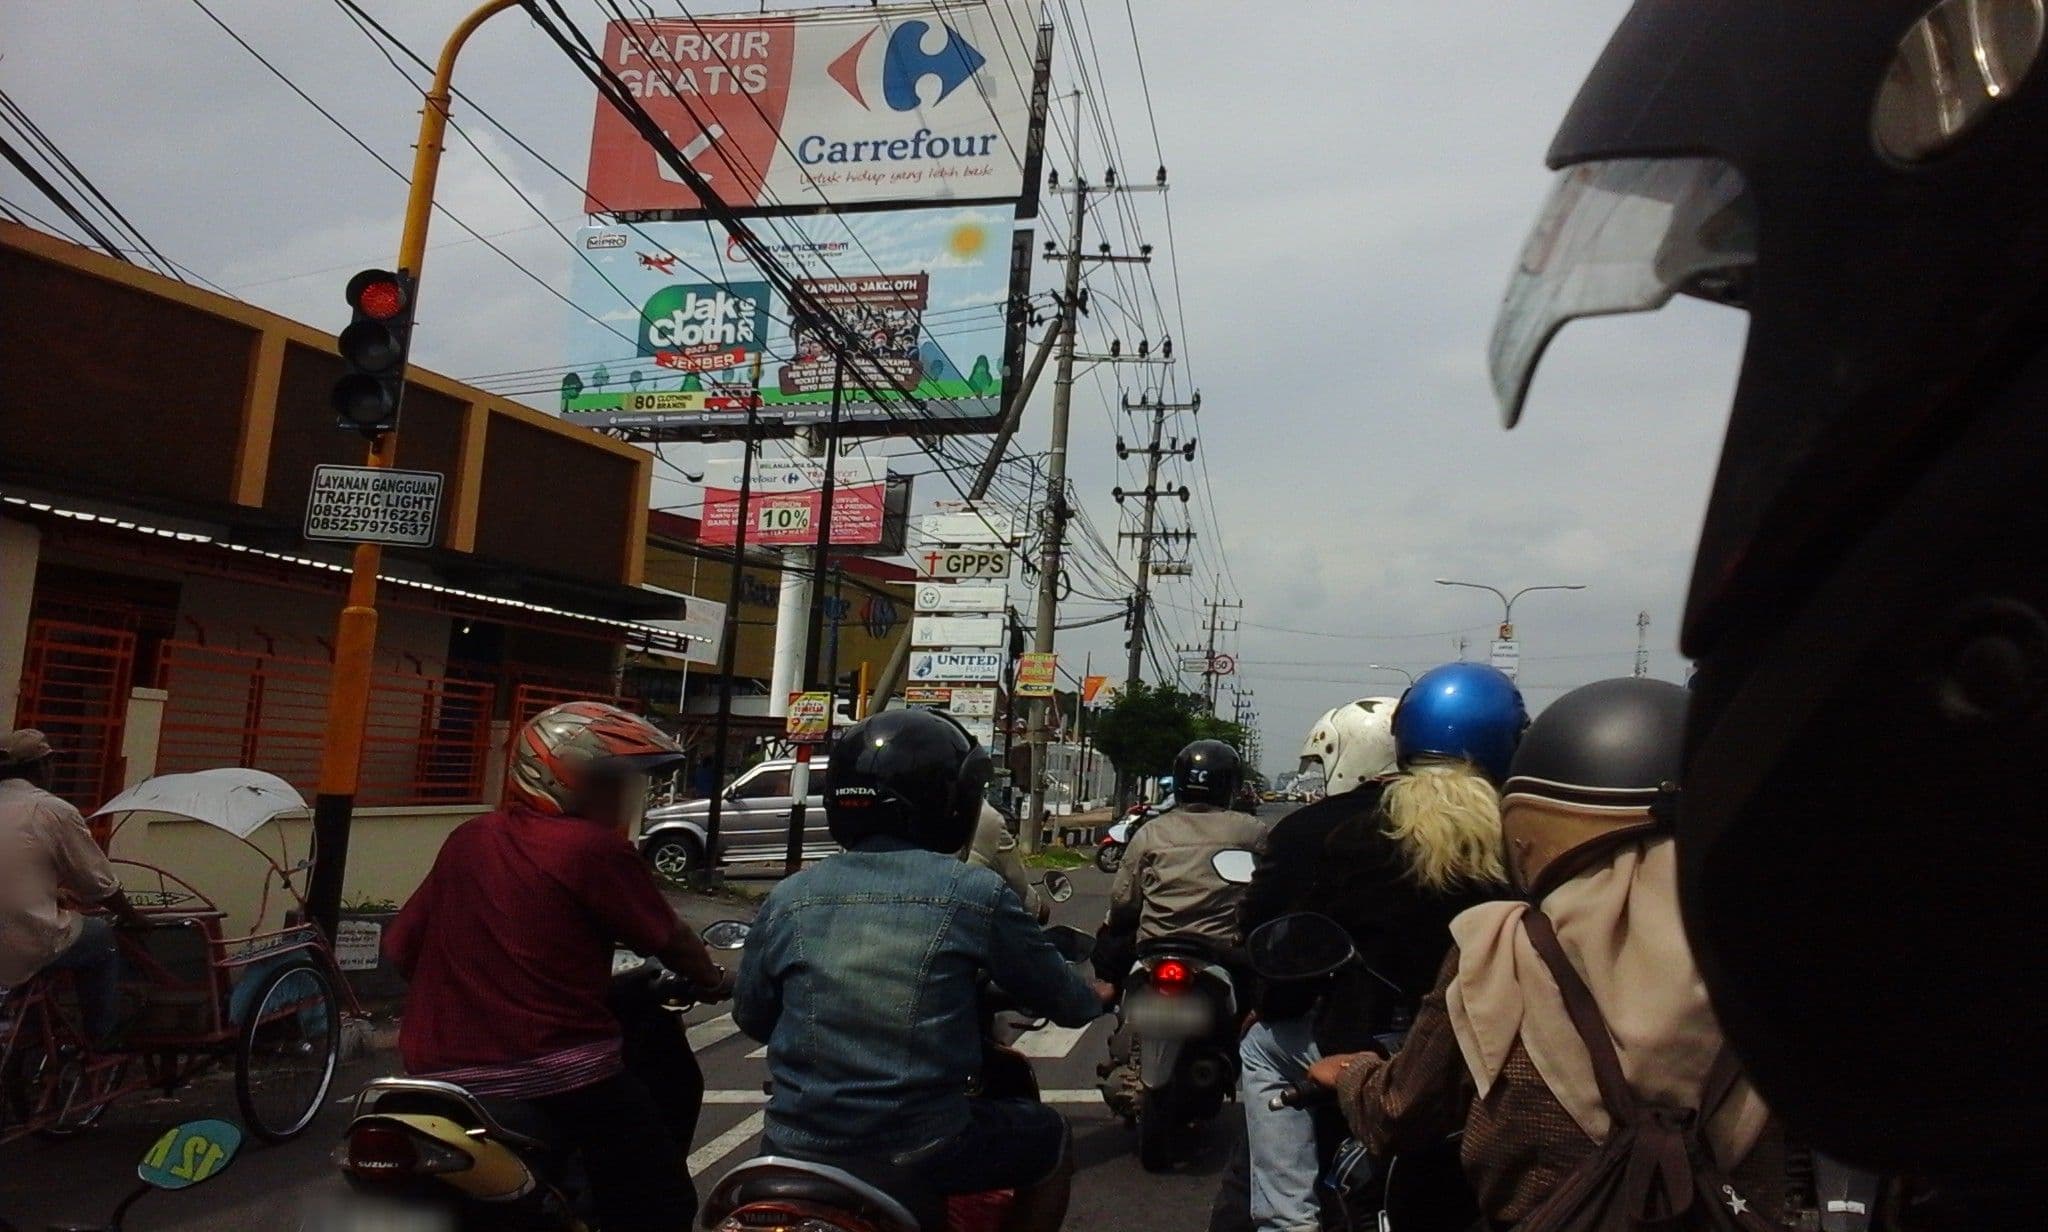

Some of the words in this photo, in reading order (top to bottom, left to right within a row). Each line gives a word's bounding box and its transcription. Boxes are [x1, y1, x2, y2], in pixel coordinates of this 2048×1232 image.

[619, 31, 770, 65] PARKIR
[616, 63, 768, 98] GRATIS
[799, 129, 996, 165] Carrefour
[890, 169, 923, 184] yang
[649, 309, 736, 348] Cloth
[664, 353, 735, 371] JEMBER
[634, 395, 656, 410] 80
[317, 475, 369, 491] LAYANAN
[371, 478, 436, 496] GANGGUAN
[315, 490, 382, 507] TRAFFIC
[385, 494, 435, 511] LIGHT
[312, 503, 432, 523] 085230116226
[763, 509, 808, 528] 10%
[311, 516, 429, 536] 085257975637
[946, 553, 1004, 574] GPPS
[937, 654, 998, 666] UNITED
[1215, 660, 1228, 670] 50
[836, 787, 877, 797] HONDA
[357, 1160, 399, 1168] SUZUKI
